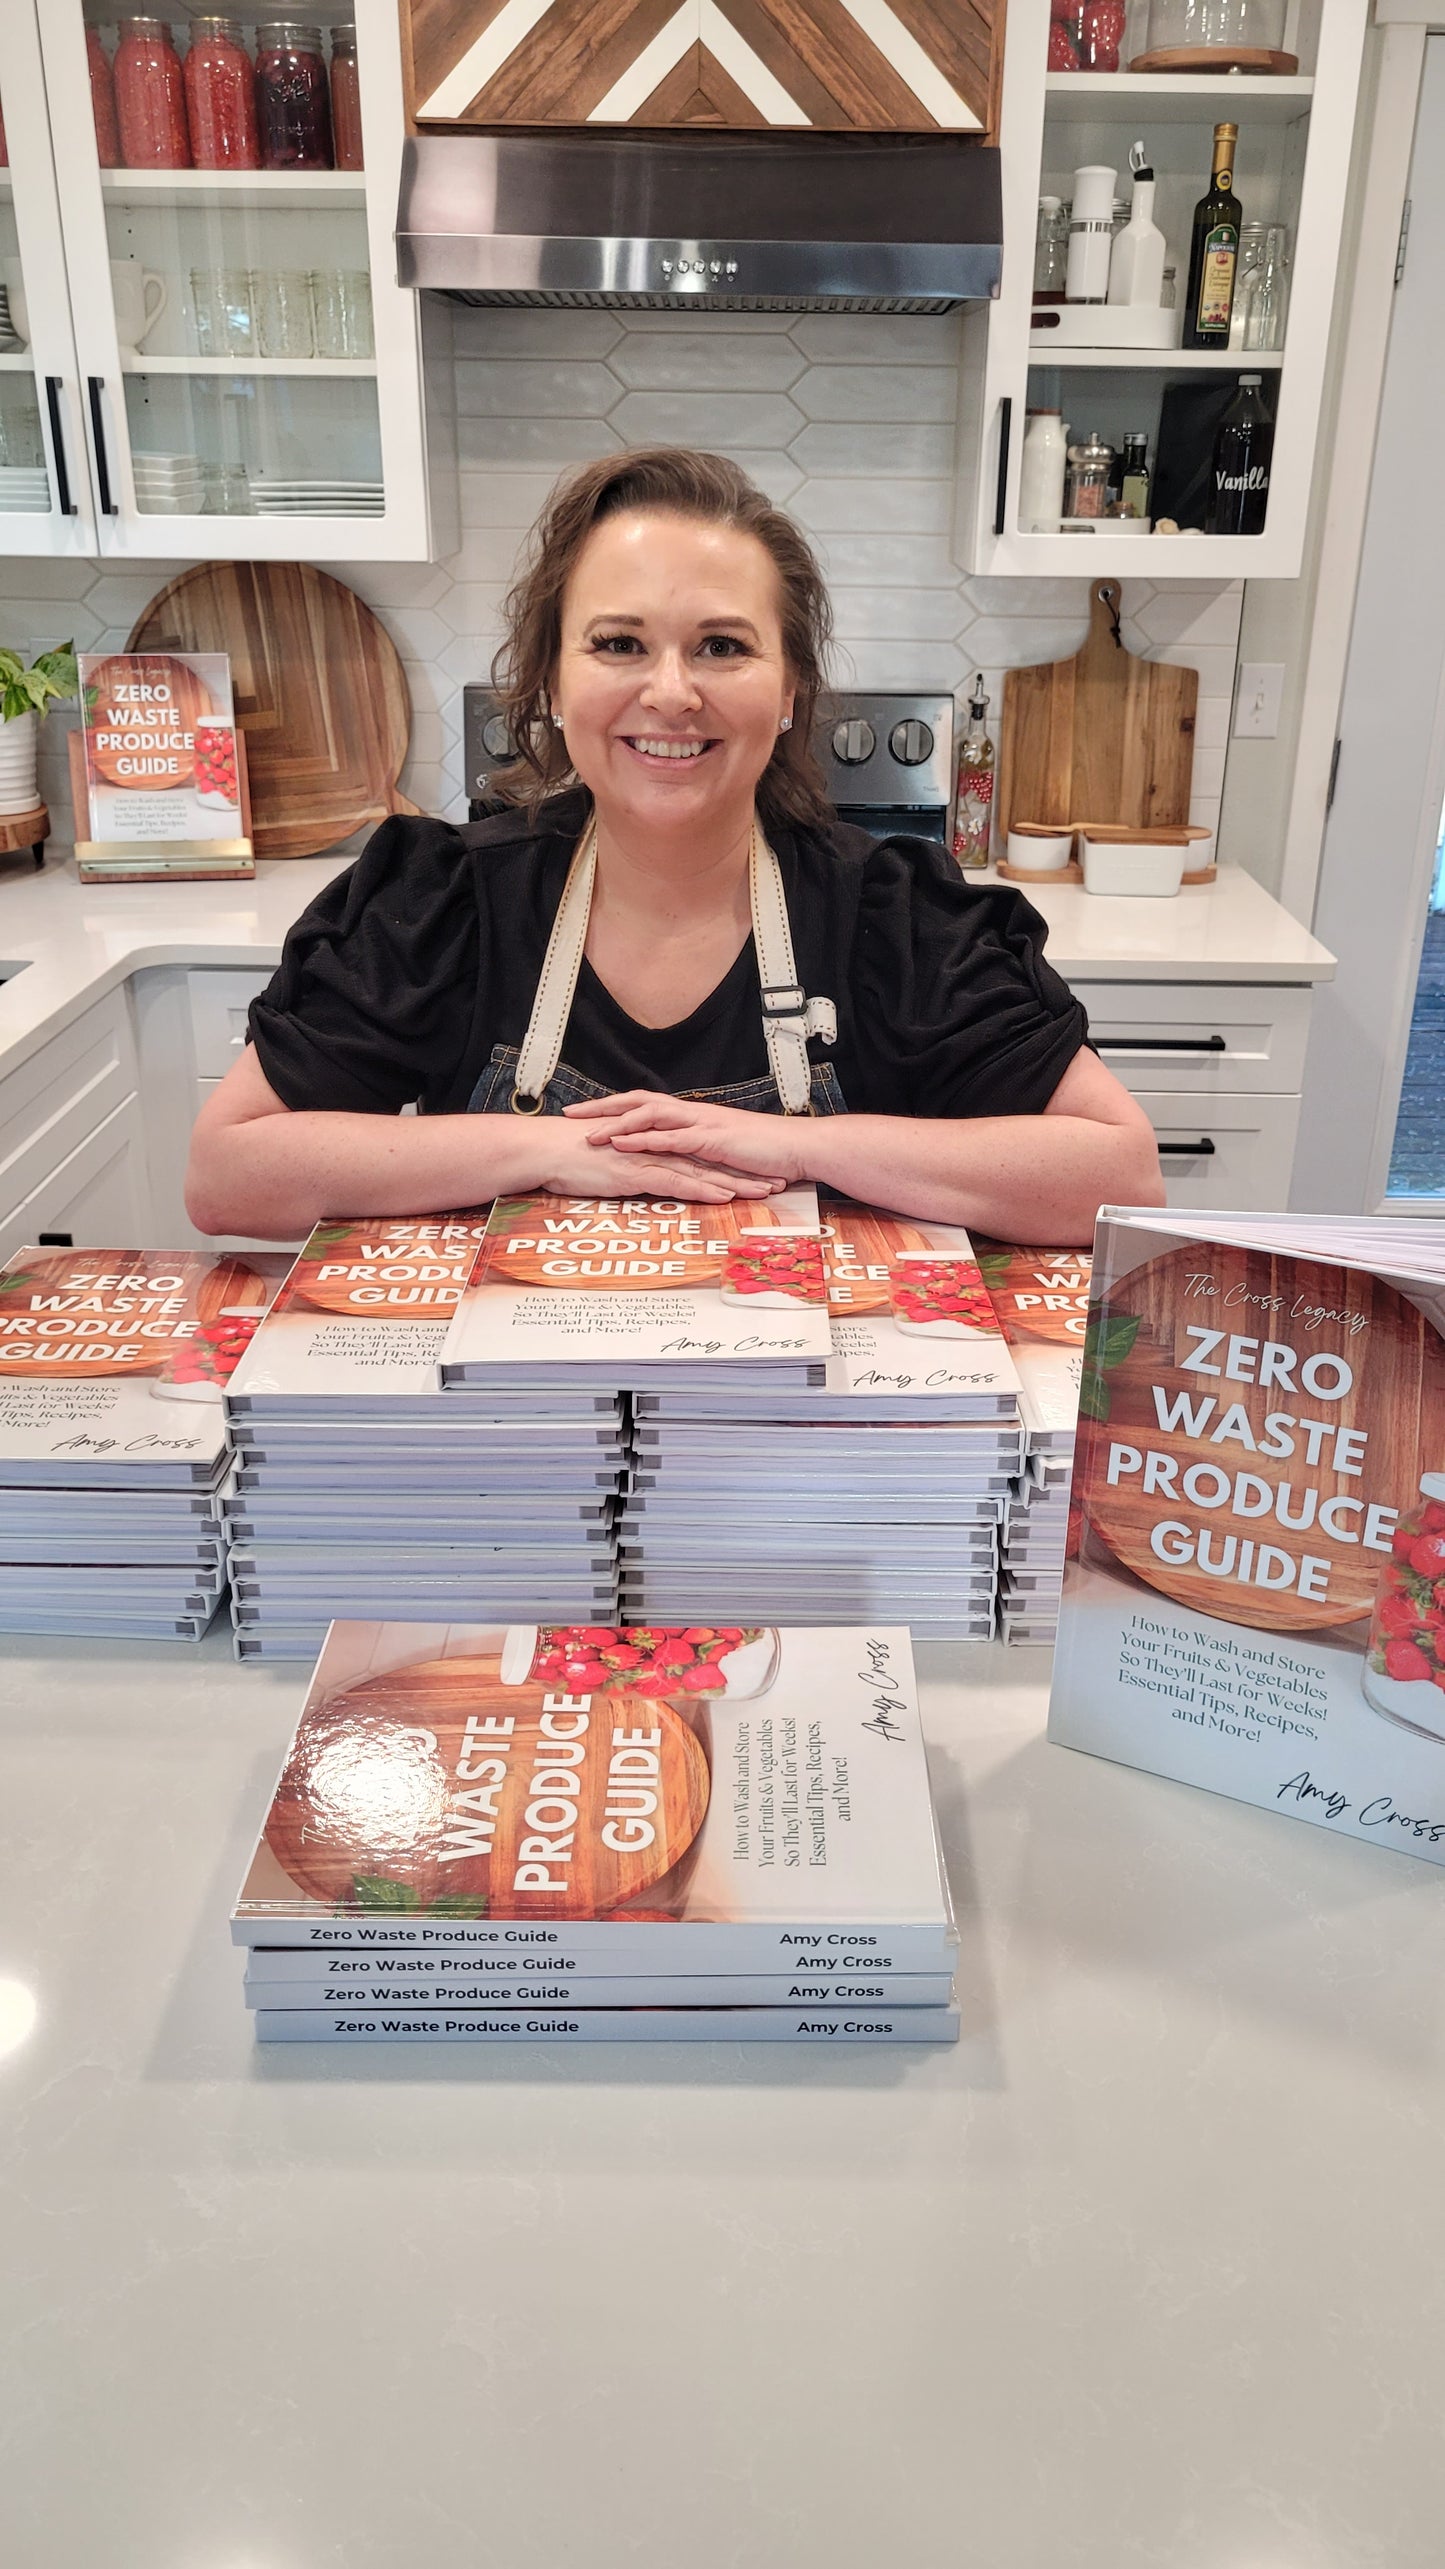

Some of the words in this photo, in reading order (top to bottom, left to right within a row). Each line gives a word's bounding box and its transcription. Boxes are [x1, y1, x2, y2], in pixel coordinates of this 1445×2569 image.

[1216, 466, 1269, 491] Vanilla
[114, 685, 171, 703] ZERO
[107, 709, 180, 726] WASTE
[96, 733, 195, 751] PRODUCE
[116, 757, 180, 775] GUIDE
[564, 1200, 687, 1215] ZERO
[543, 1219, 701, 1235] WASTE
[361, 1244, 479, 1260] WAS
[505, 1238, 729, 1256] PRODUCE
[541, 1259, 686, 1277] GUIDE
[1045, 1253, 1093, 1268] ZE
[59, 1274, 185, 1292] ZERO
[316, 1265, 470, 1282] PRODU
[30, 1295, 188, 1314] WASTE
[349, 1287, 463, 1304] GUID
[1182, 1272, 1221, 1298] The
[1224, 1282, 1286, 1312] Cross
[1290, 1294, 1370, 1334] Legacy
[0, 1342, 144, 1362] GUIDE
[660, 1337, 726, 1353] Amy
[733, 1336, 812, 1352] Cross
[1179, 1325, 1354, 1401] ZERO
[853, 1370, 916, 1388] Amy
[925, 1369, 1000, 1386] Cross
[1152, 1385, 1368, 1477] WASTE
[50, 1433, 121, 1453] Amy
[124, 1433, 205, 1451] Cross
[1106, 1442, 1399, 1554] PRODUCE
[1149, 1521, 1332, 1604] GUIDE
[1131, 1615, 1169, 1637] How
[1172, 1628, 1189, 1642] to
[1193, 1631, 1239, 1656] Wash
[1242, 1648, 1275, 1666] and
[1277, 1655, 1326, 1680] Store
[857, 1638, 899, 1691] Cross
[1121, 1631, 1160, 1653] Your
[1163, 1643, 1211, 1668] Fruits
[1214, 1658, 1231, 1673] &
[1234, 1662, 1328, 1701] Vegetables
[1119, 1650, 1140, 1667] So
[1144, 1656, 1196, 1682] They'll
[1199, 1672, 1234, 1694] Last
[1237, 1683, 1264, 1701] for
[1267, 1691, 1328, 1721] Weeks!
[1118, 1668, 1195, 1703] Essential
[1199, 1690, 1239, 1717] Tips,
[1244, 1704, 1319, 1741] Recipes,
[861, 1694, 907, 1742] Amy
[1171, 1707, 1205, 1727] and
[1208, 1715, 1262, 1743] More!
[735, 1722, 749, 1753] Store
[780, 1717, 797, 1757] Weeks!
[805, 1721, 826, 1771] Recipes,
[757, 1719, 778, 1781] Vegetables
[732, 1755, 749, 1777] and
[781, 1759, 797, 1777] for
[831, 1757, 849, 1794] More!
[437, 1715, 516, 1863] WASTE
[513, 1693, 593, 1892] PRODUCE
[601, 1727, 662, 1853] GUIDE
[732, 1779, 749, 1813] Wash
[758, 1783, 774, 1795] &
[783, 1780, 798, 1805] Last
[806, 1774, 829, 1803] Tips,
[758, 1797, 774, 1833] Fruits
[832, 1796, 852, 1822] and
[1276, 1770, 1353, 1819] Amy
[1358, 1796, 1445, 1843] Cross
[735, 1815, 749, 1828] to
[781, 1807, 802, 1847] They'll
[733, 1830, 749, 1860] How
[805, 1806, 827, 1866] Essential
[758, 1836, 775, 1868] Your
[784, 1850, 800, 1867] So
[310, 1928, 353, 1940] Zero
[357, 1929, 417, 1941] Waste
[422, 1930, 499, 1942] Produce
[504, 1930, 559, 1943] Guide
[779, 1934, 822, 1947] Amy
[827, 1934, 877, 1945] Cross
[328, 1960, 370, 1972] Zero
[375, 1959, 435, 1971] Waste
[440, 1958, 517, 1971] Produce
[522, 1958, 577, 1970] Guide
[796, 1956, 838, 1969] Amy
[842, 1956, 892, 1967] Cross
[323, 1988, 366, 2000] Zero
[371, 1988, 430, 2000] Waste
[435, 1987, 512, 2000] Produce
[516, 1986, 570, 1999] Guide
[788, 1986, 830, 1999] Amy
[834, 1986, 884, 1997] Cross
[334, 2020, 376, 2033] Zero
[381, 2020, 440, 2033] Waste
[445, 2020, 521, 2033] Produce
[526, 2020, 580, 2033] Guide
[797, 2022, 839, 2035] Amy
[843, 2022, 893, 2033] Cross
